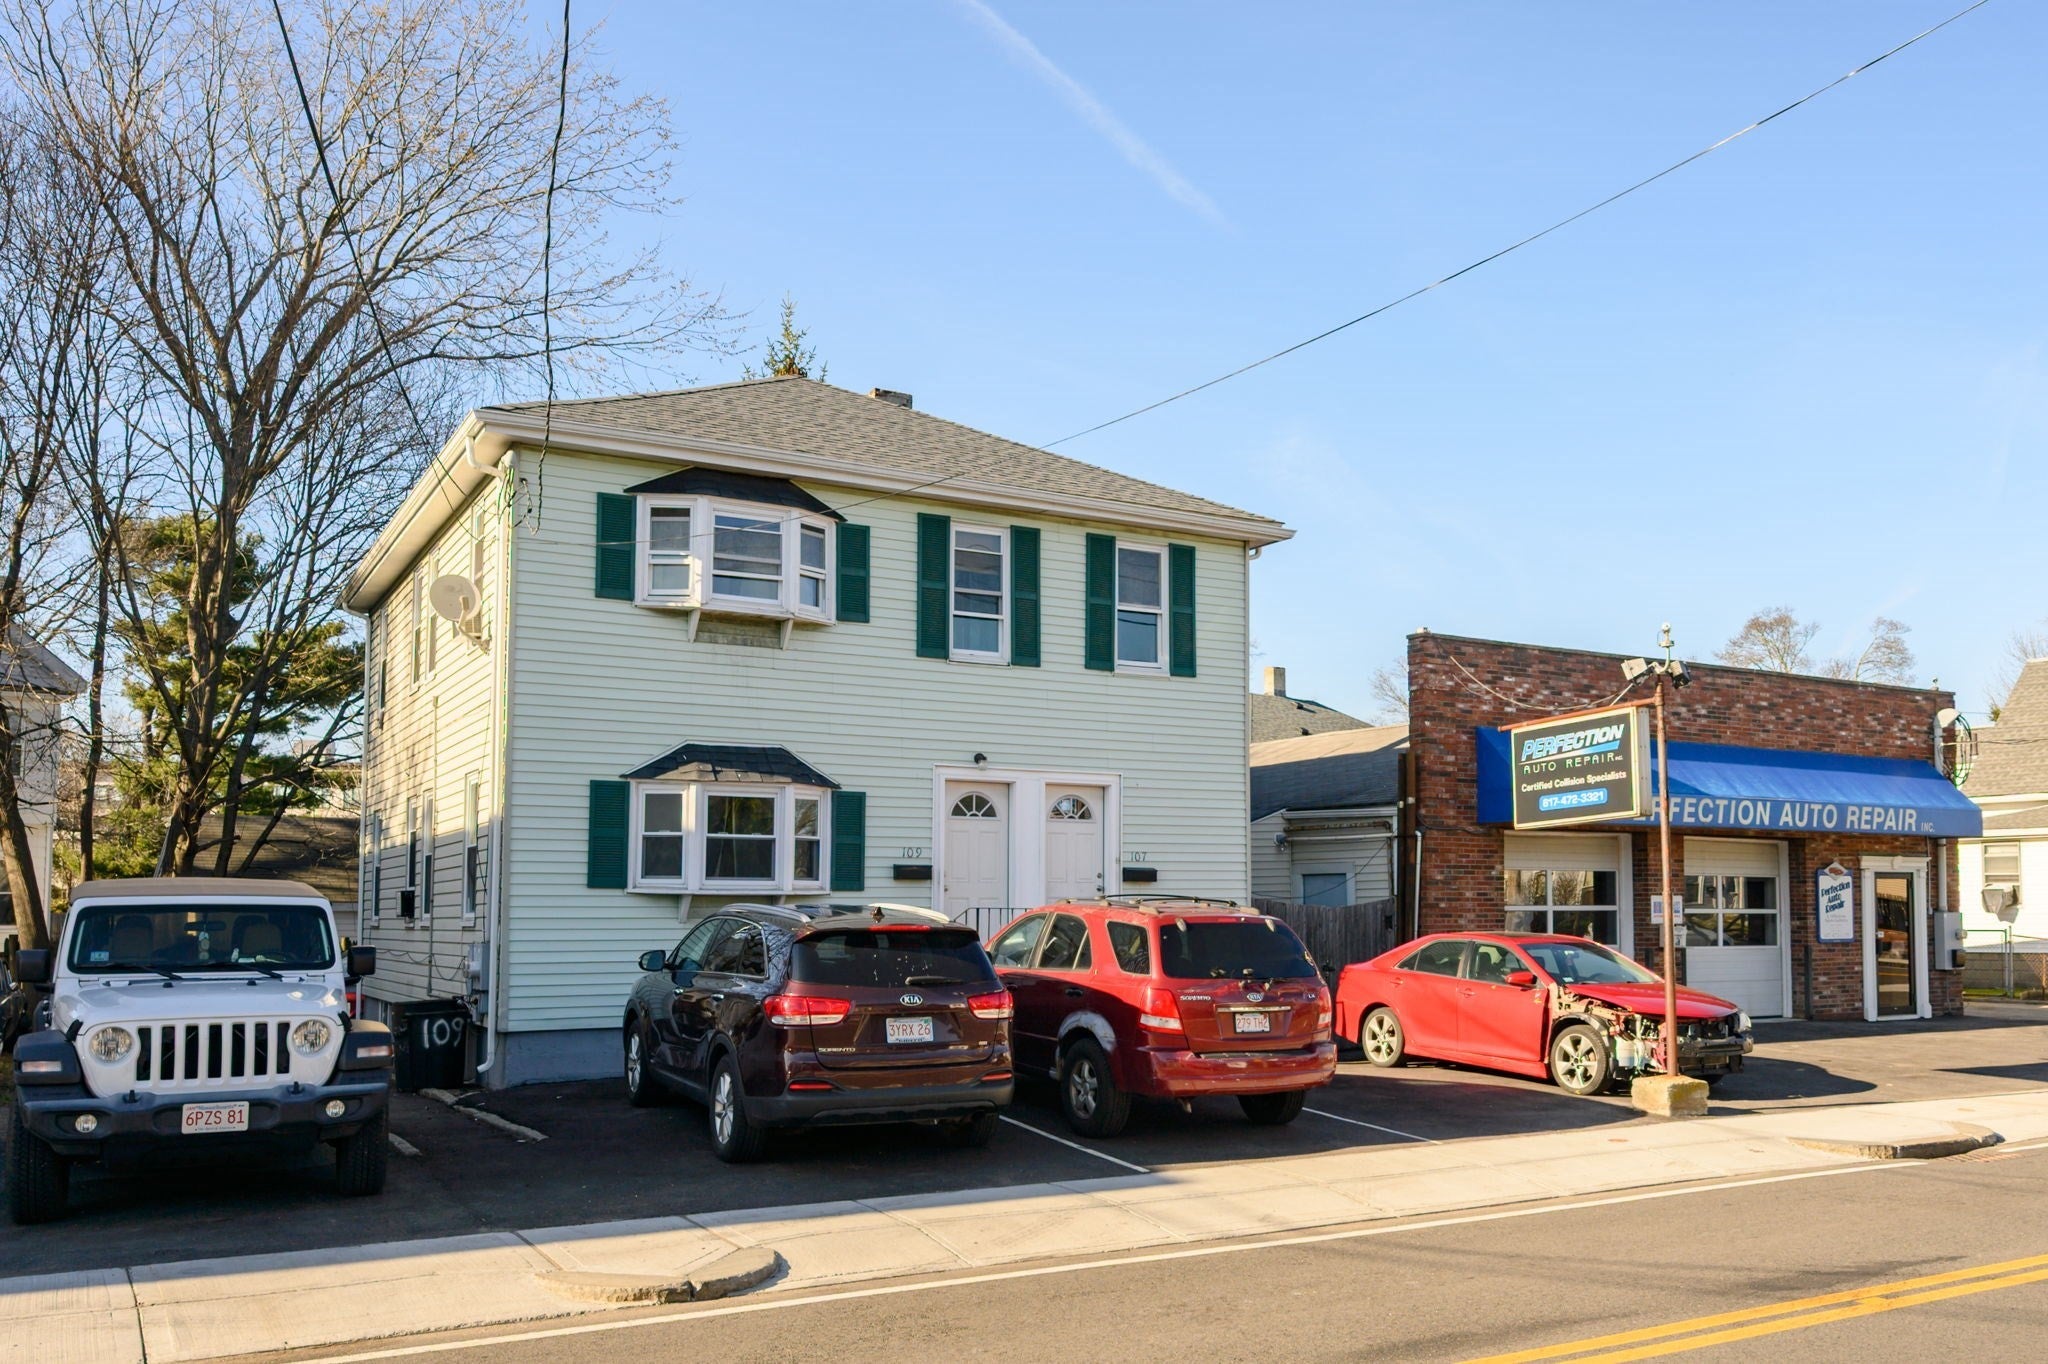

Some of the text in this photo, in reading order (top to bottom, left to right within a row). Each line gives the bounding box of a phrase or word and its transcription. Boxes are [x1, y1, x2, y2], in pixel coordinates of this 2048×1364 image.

[1521, 724, 1625, 762] PERFECTION
[1523, 761, 1556, 775] AUTO
[1566, 752, 1615, 769] REPAIR
[1521, 771, 1627, 792] Certified Collision Specialists
[1542, 791, 1604, 808] 617-472-3321
[1633, 796, 1935, 833] RFECTION AUTO REPAIR INC.
[902, 846, 922, 858] 109
[1130, 851, 1148, 863] 107
[1821, 881, 1851, 897] Perfection
[1827, 892, 1841, 904] Auto
[1825, 900, 1845, 914] Repair
[423, 1017, 465, 1049] 109
[888, 1023, 931, 1037] 3YRX 26
[185, 1109, 245, 1126] 6PZS 81
